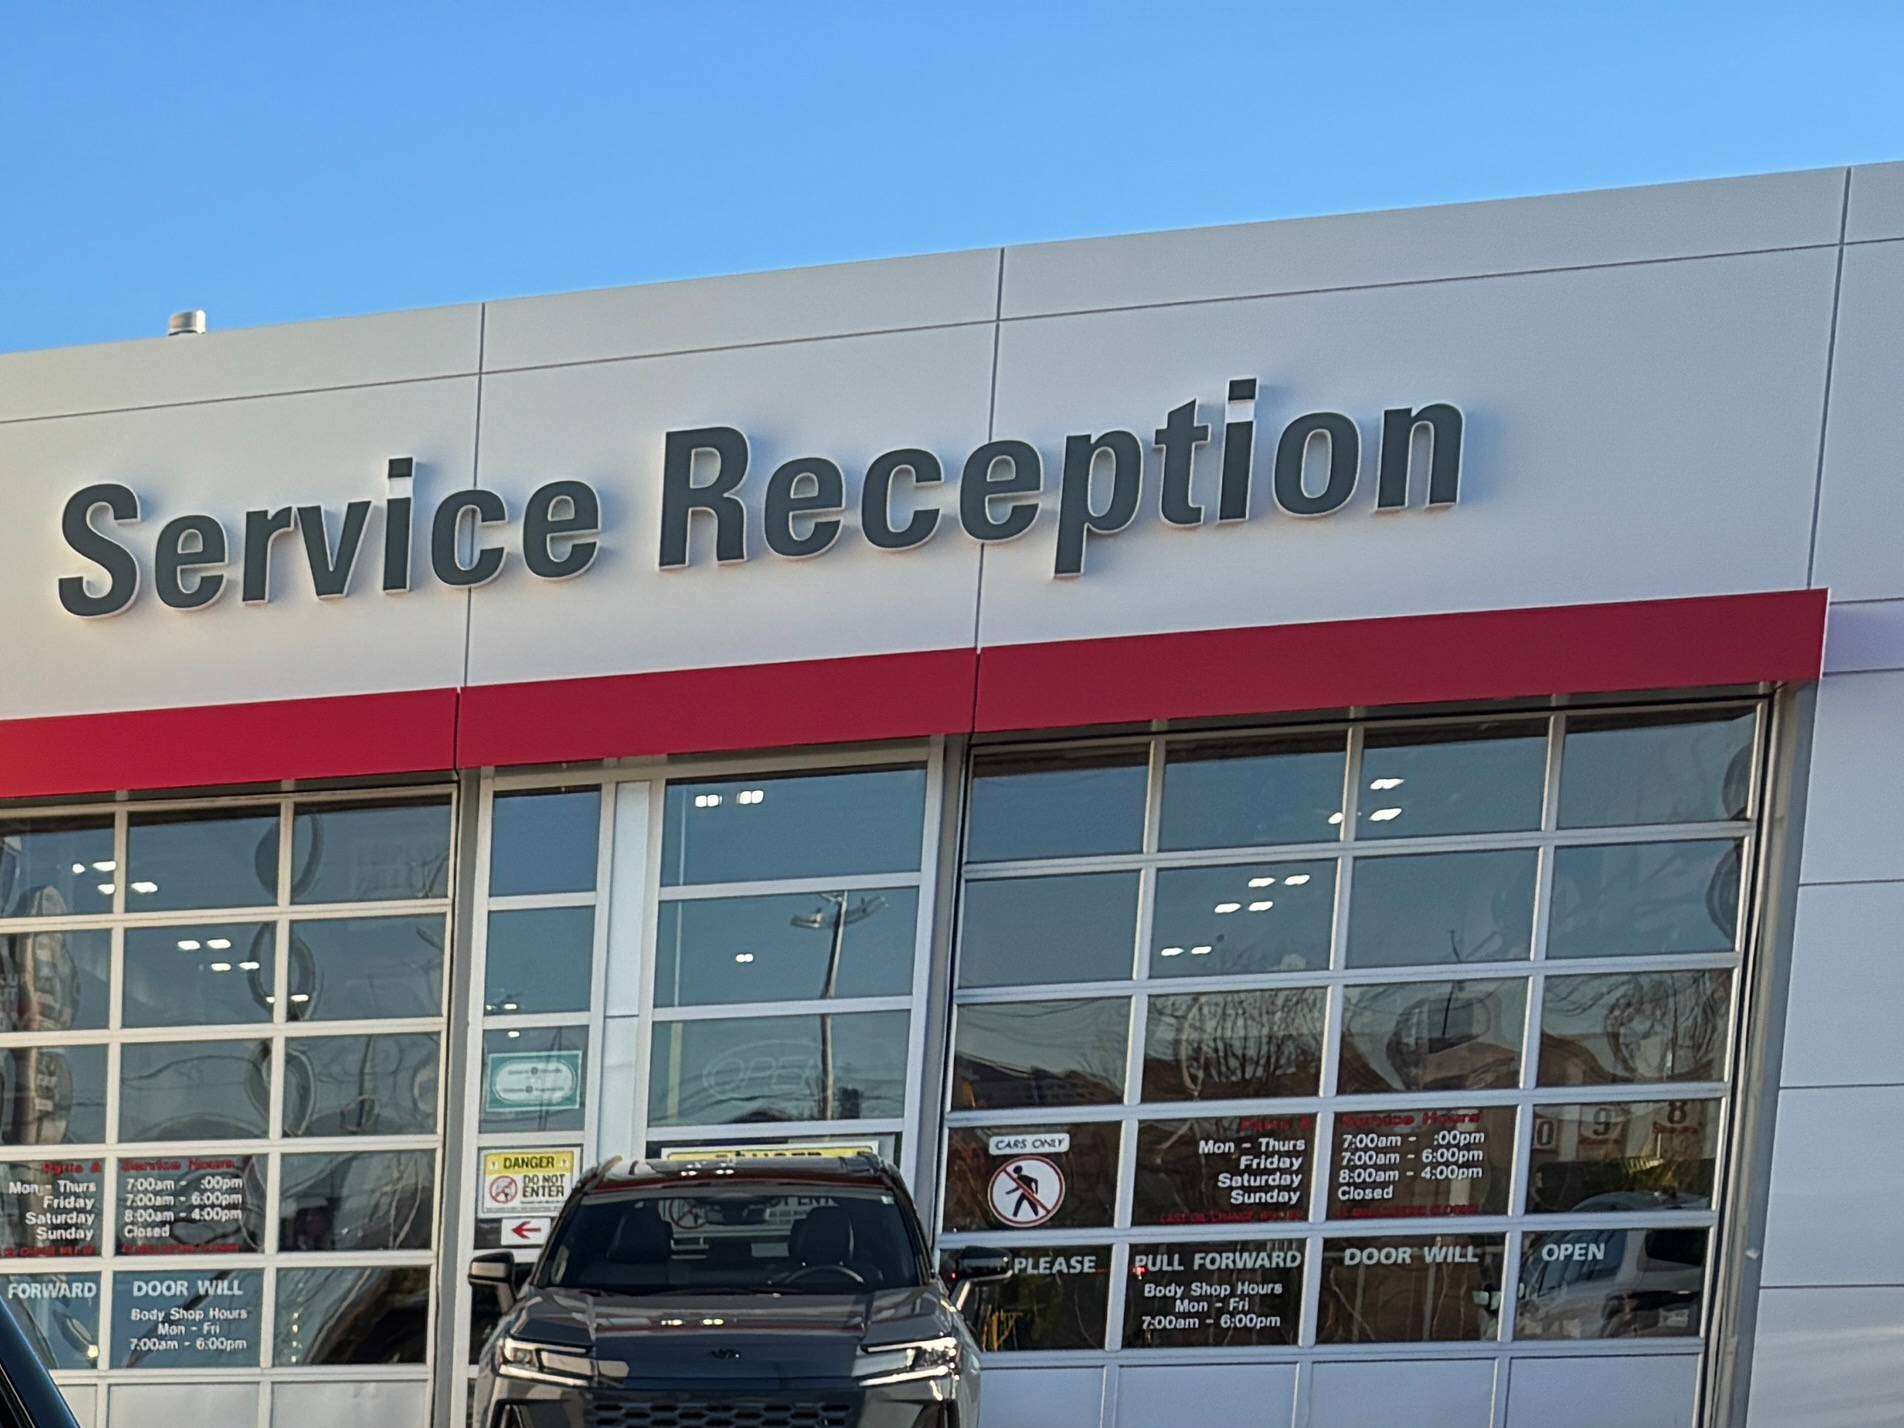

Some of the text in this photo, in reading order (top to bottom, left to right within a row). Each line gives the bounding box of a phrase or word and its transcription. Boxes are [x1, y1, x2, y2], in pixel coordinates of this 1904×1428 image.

[57, 378, 1466, 618] Service Reception
[995, 1138, 1065, 1150] CARS ONLY
[1199, 1140, 1235, 1154] Mon
[1259, 1137, 1305, 1152] Thurs
[1343, 1134, 1401, 1148] 7:00am
[503, 1156, 555, 1169] DANGER
[1240, 1155, 1303, 1170] Friday
[1342, 1151, 1400, 1165] 7:00am
[1422, 1149, 1483, 1164] 6:00pm
[523, 1174, 565, 1185] DO NOT
[1217, 1172, 1302, 1188] Saturday
[1339, 1168, 1398, 1182] 8:00am
[1421, 1166, 1482, 1181] 4:00pm
[9, 1182, 38, 1194] Mon
[59, 1180, 96, 1193] Thurs
[126, 1178, 174, 1191] 7:00am
[522, 1185, 564, 1198] ENTER
[43, 1196, 95, 1211] Friday
[125, 1193, 174, 1207] 7:00am
[192, 1192, 242, 1206] 6:00pm
[1230, 1186, 1392, 1205] Sunday Closed
[26, 1212, 95, 1226] Saturday
[124, 1209, 174, 1223] 8:00am
[191, 1207, 242, 1222] 4:00pm
[36, 1224, 171, 1241] Sunday Closed
[1013, 1242, 1605, 1274] PLEASE PULL FORWARD DOOR WILL OPEN
[8, 1280, 243, 1300] FORWARD DOOR WILL
[1144, 1281, 1282, 1298] Body Shop Hours
[1175, 1300, 1207, 1313] Mon
[1229, 1298, 1249, 1311] Fri
[131, 1307, 247, 1322] Body Shop Hours
[1142, 1316, 1199, 1329] 7:00am
[1220, 1314, 1280, 1329] 6:00pm
[158, 1324, 185, 1335] Mon
[203, 1322, 220, 1335] Fri
[130, 1338, 178, 1351] 7:00am
[196, 1337, 247, 1351] 6:00pm
